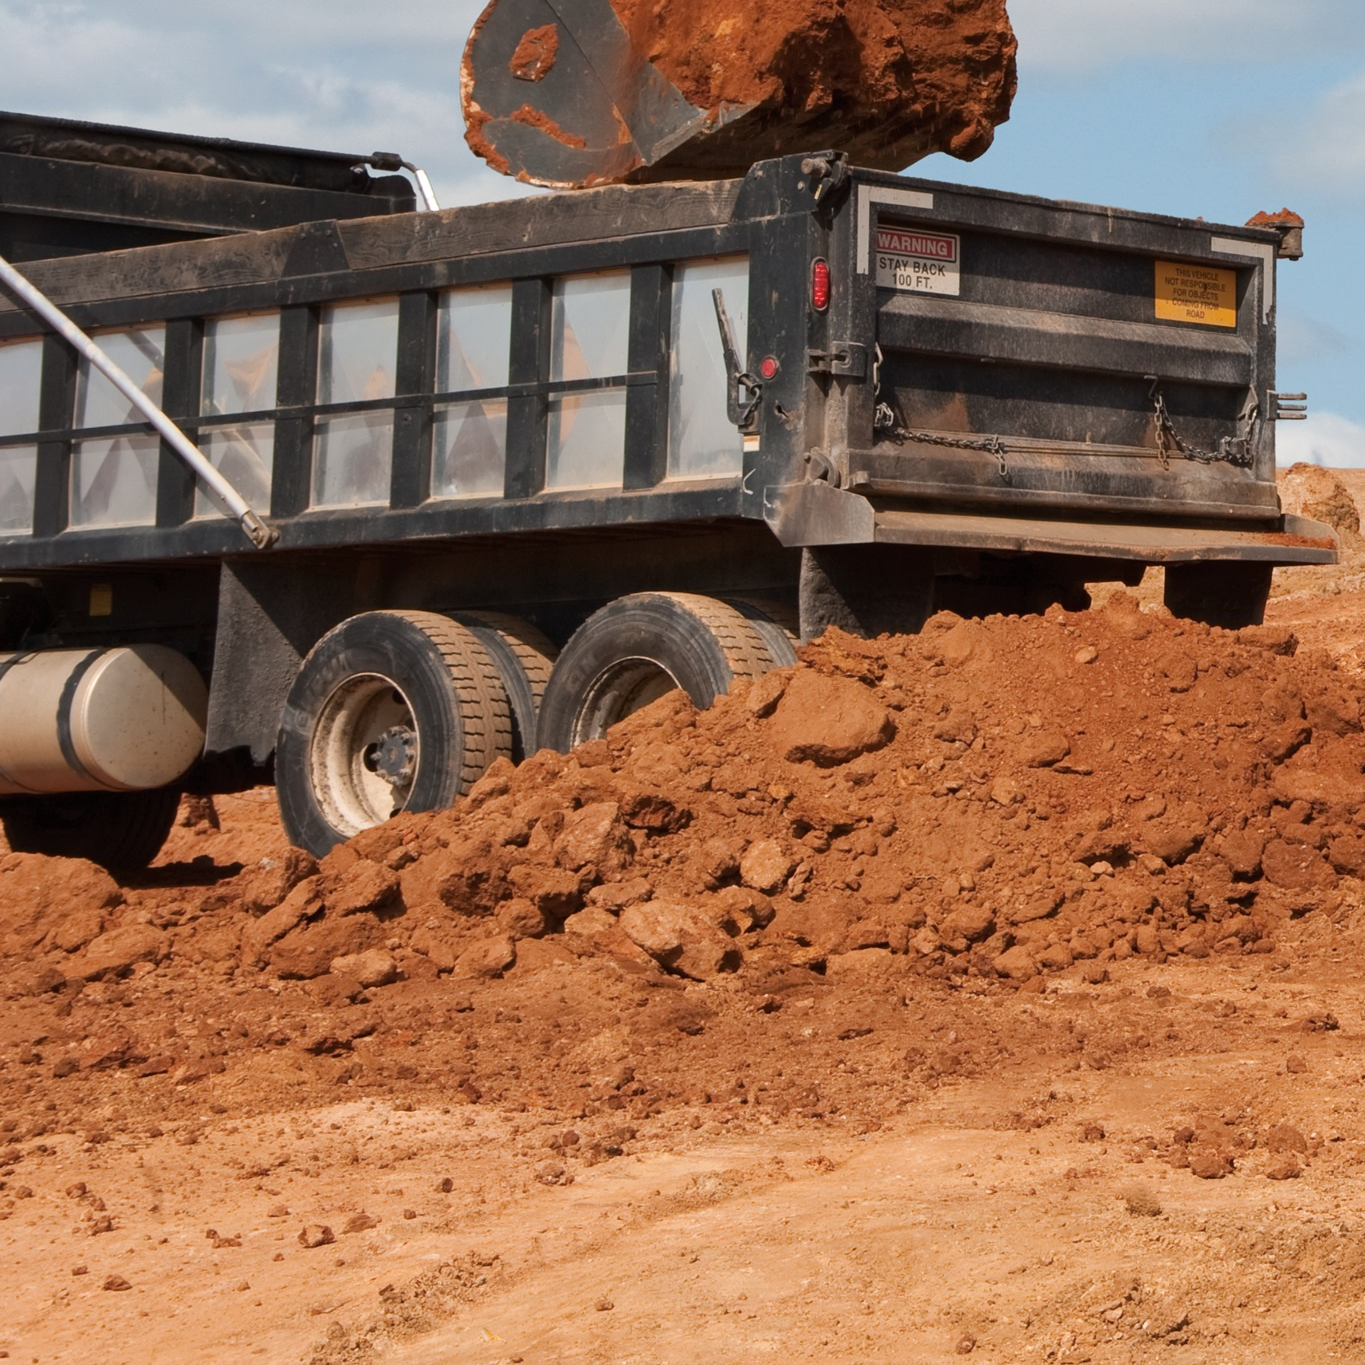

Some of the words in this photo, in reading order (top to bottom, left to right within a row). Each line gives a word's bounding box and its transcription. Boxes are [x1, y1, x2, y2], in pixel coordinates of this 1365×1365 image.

[877, 234, 948, 256] WARNING
[879, 257, 908, 272] STAY
[913, 261, 946, 277] BACK
[892, 273, 912, 287] 100
[916, 276, 932, 289] FT.
[1176, 268, 1190, 277] THIS
[1192, 270, 1219, 281] VEHICLE
[1165, 277, 1179, 286] NOT
[1173, 288, 1187, 297] FOR
[1188, 290, 1219, 301] OBJECTS
[1172, 298, 1200, 308] COMING
[1200, 301, 1220, 311] FROM
[1186, 310, 1205, 319] ROAD
